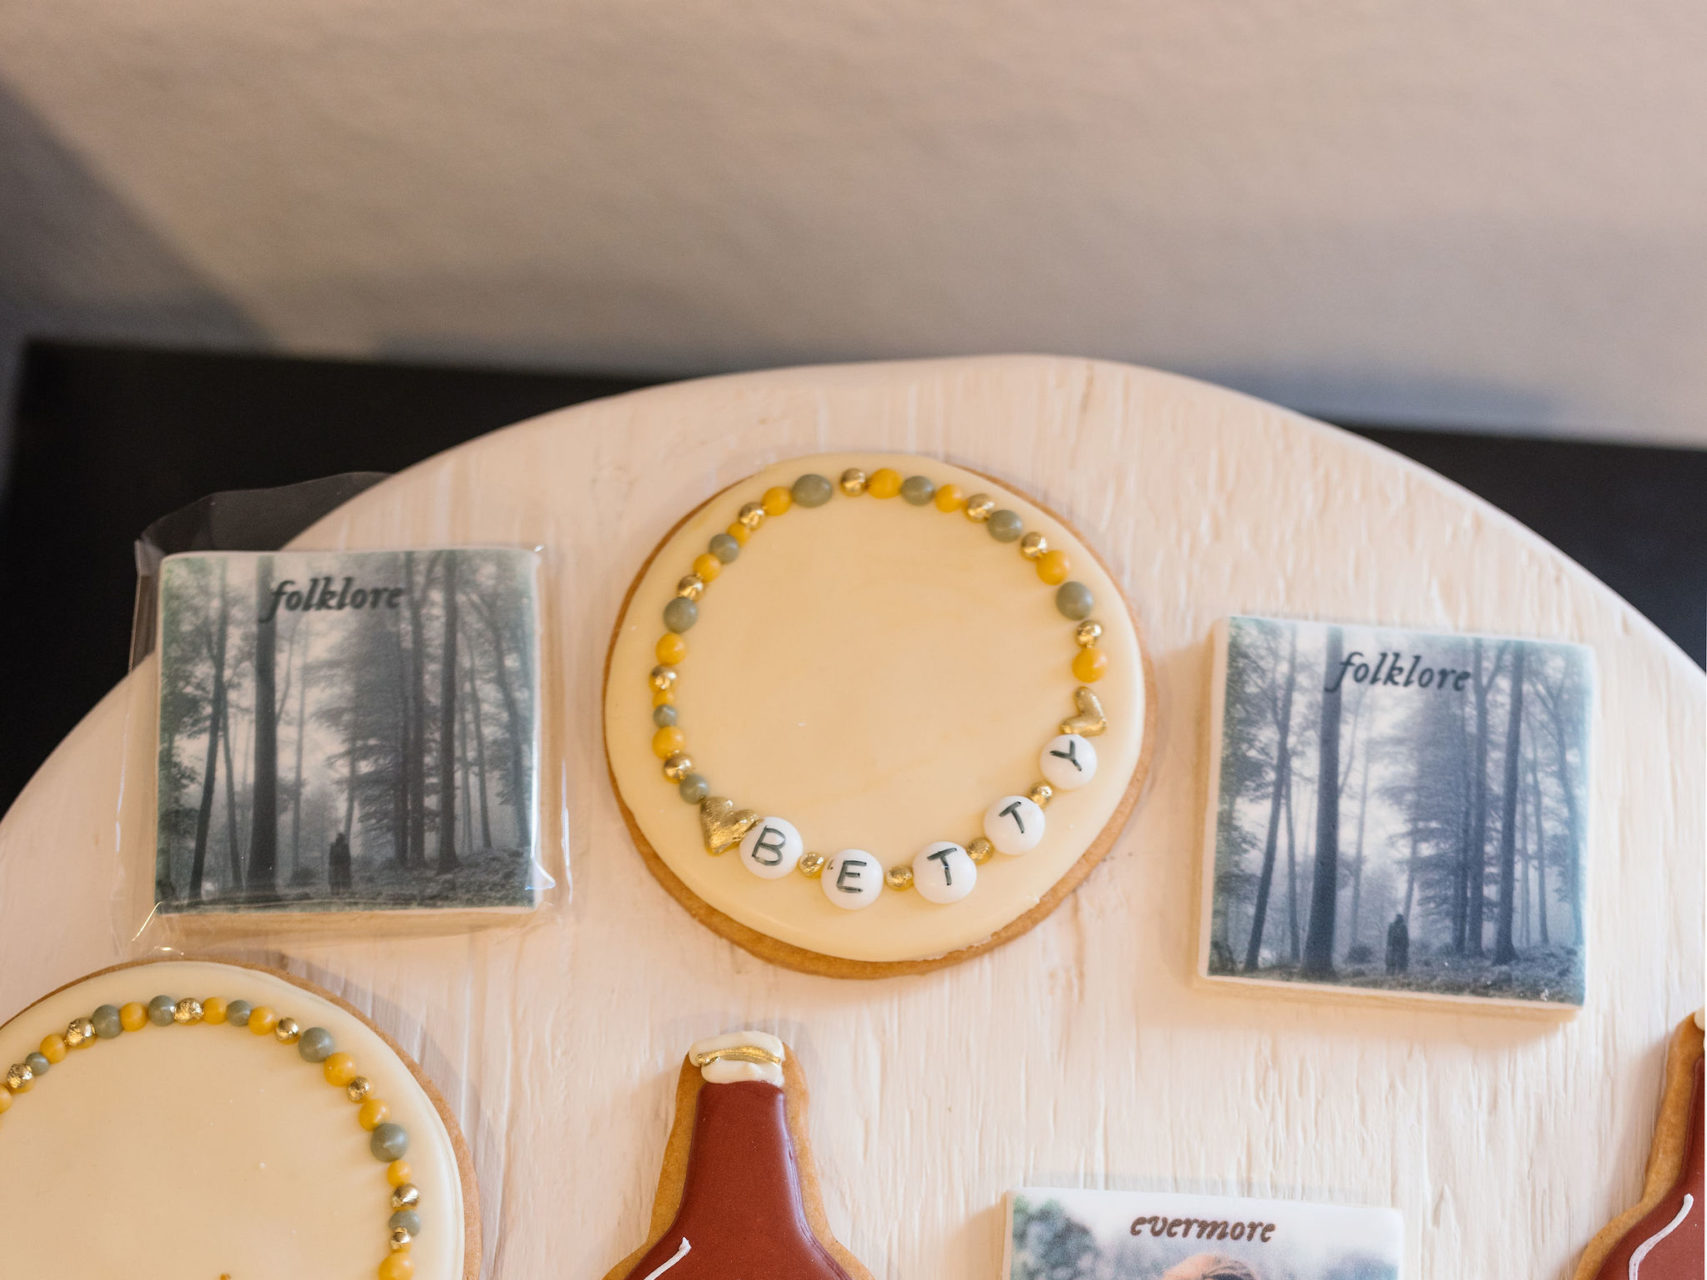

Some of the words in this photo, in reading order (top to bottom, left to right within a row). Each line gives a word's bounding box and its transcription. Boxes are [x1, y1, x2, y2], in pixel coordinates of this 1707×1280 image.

[258, 576, 405, 624] folklore
[1324, 651, 1472, 693] folklore
[751, 739, 1082, 894] BETTY
[1130, 1215, 1276, 1243] evermore
